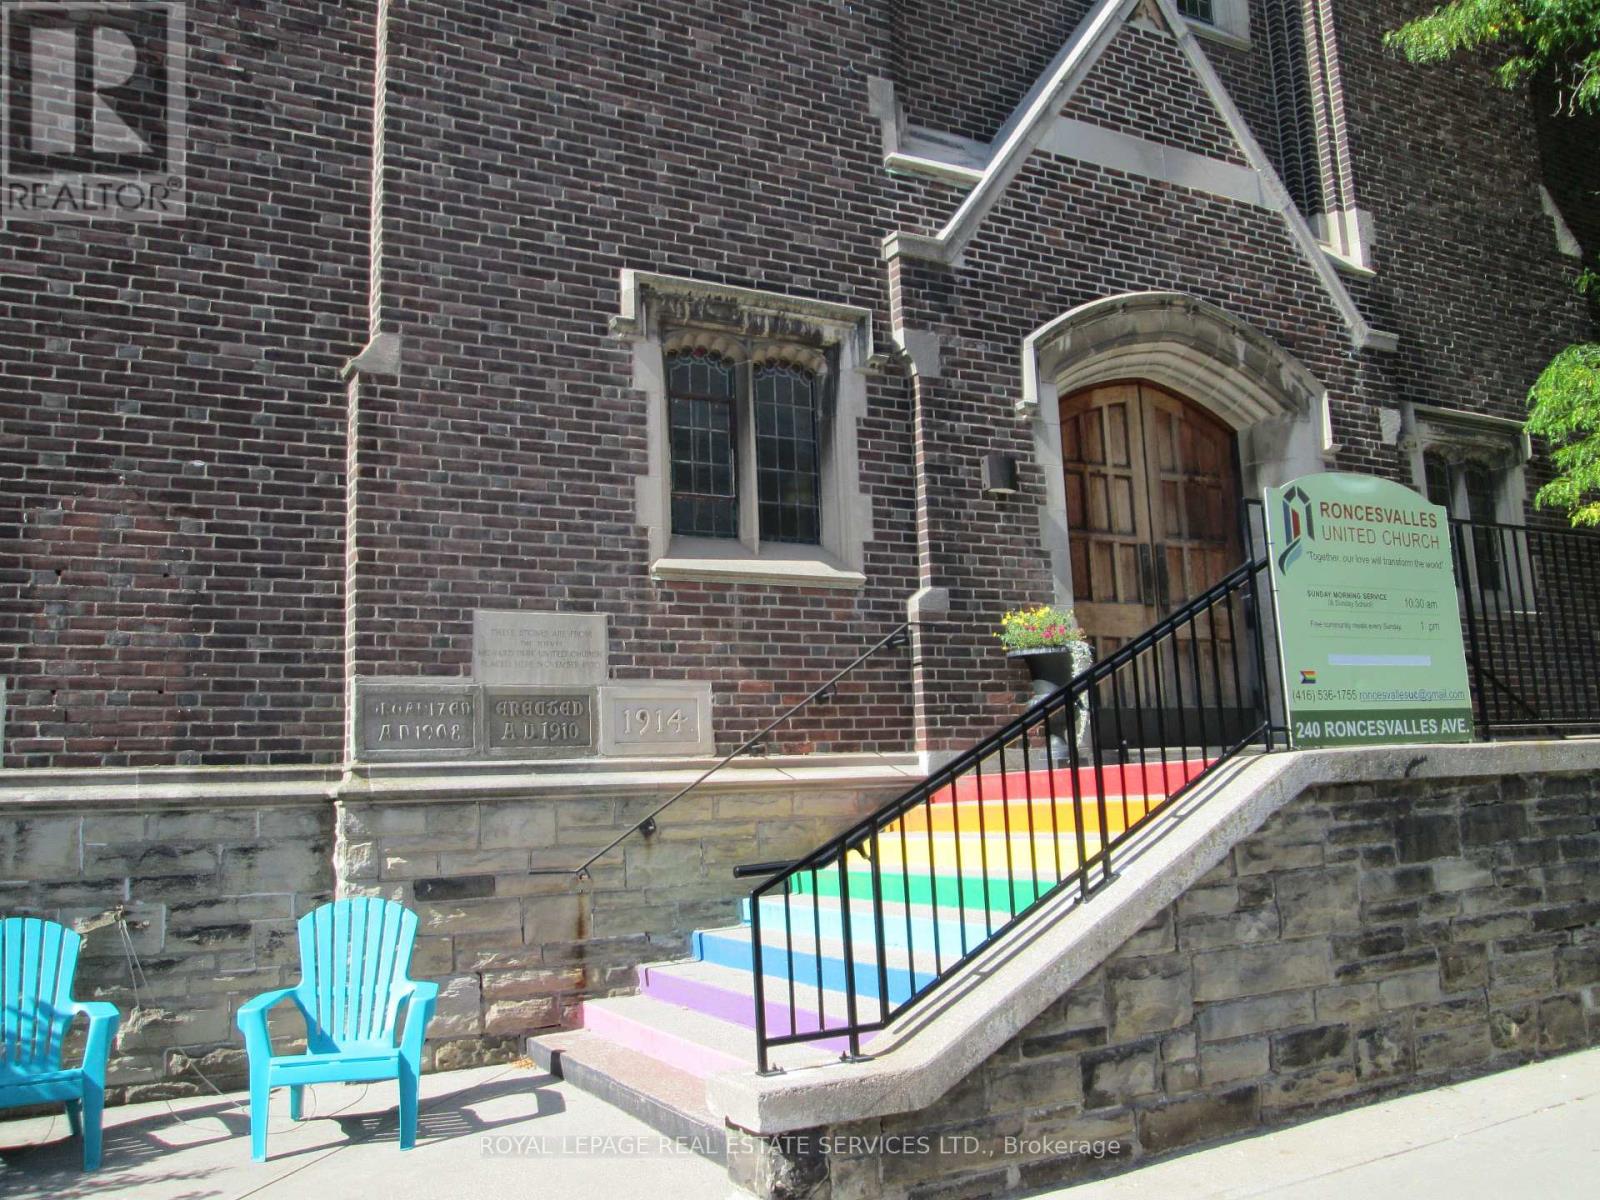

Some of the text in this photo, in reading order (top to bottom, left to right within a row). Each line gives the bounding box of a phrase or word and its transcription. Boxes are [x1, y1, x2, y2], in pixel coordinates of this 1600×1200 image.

[1319, 501, 1438, 529] RONCESVALLES
[1322, 525, 1440, 550] UNITED CHURCH
[1343, 555, 1353, 564] our
[1355, 554, 1371, 566] love
[1371, 556, 1382, 566] will
[1383, 557, 1414, 568] transform
[1415, 559, 1425, 568] the
[1306, 590, 1388, 601] SUNDAY MORNING SERVICE
[1404, 598, 1438, 609] 10:30 am
[1428, 622, 1440, 632] pm
[1292, 688, 1465, 703] (416) 536-1755 roncesvallesuc@gmail.com
[495, 699, 584, 717] ERECTED
[1296, 717, 1470, 739] 240 RONCESVALLES AVE.
